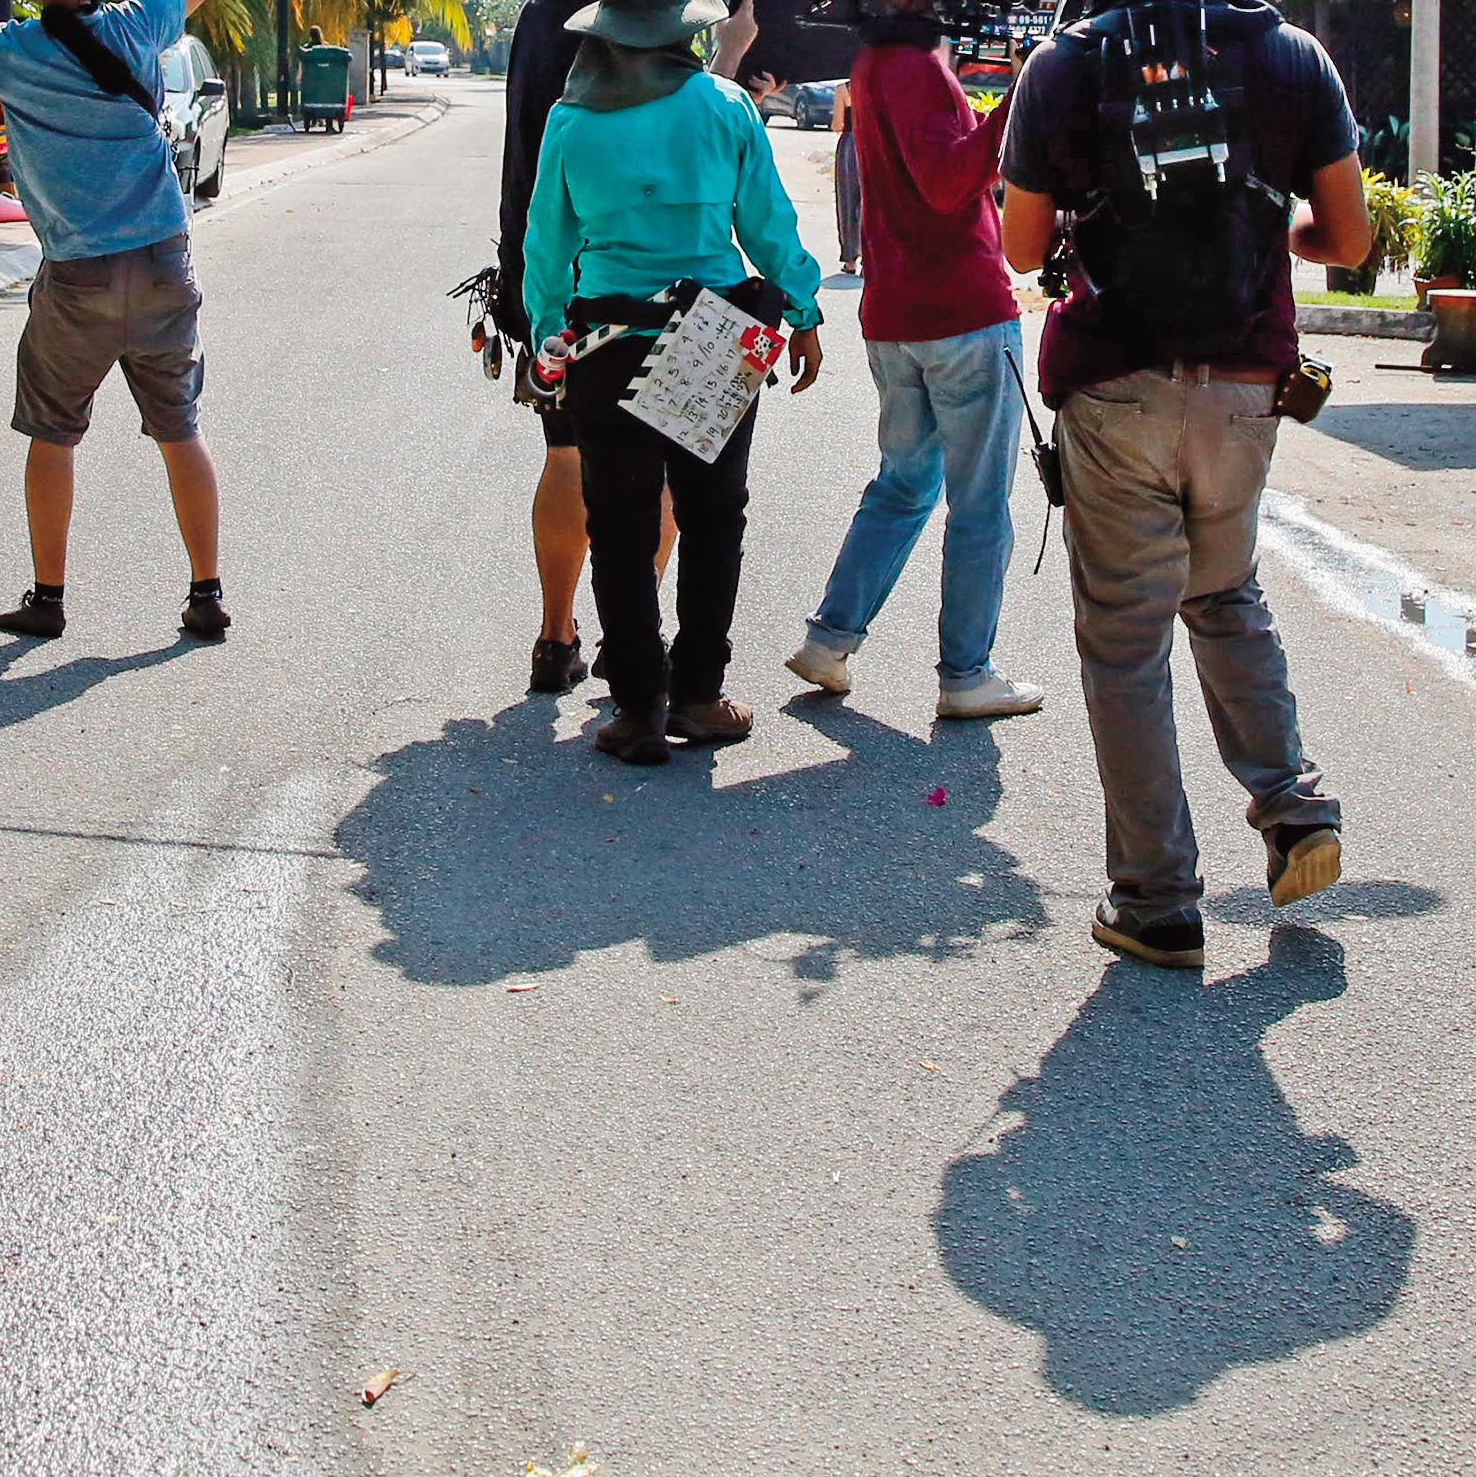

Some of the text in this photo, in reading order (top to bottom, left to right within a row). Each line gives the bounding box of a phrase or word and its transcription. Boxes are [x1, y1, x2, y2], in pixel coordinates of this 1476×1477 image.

[654, 378, 663, 388] 2
[668, 368, 680, 378] 5
[668, 398, 677, 407] 7
[692, 359, 703, 368] 9
[703, 341, 715, 354] 10
[676, 430, 689, 442] 12
[685, 410, 699, 423] 13
[694, 397, 708, 409] 14
[704, 380, 717, 391] 15
[715, 364, 729, 376] 16
[725, 348, 736, 359] 17
[697, 408, 729, 454] 18 19 20
